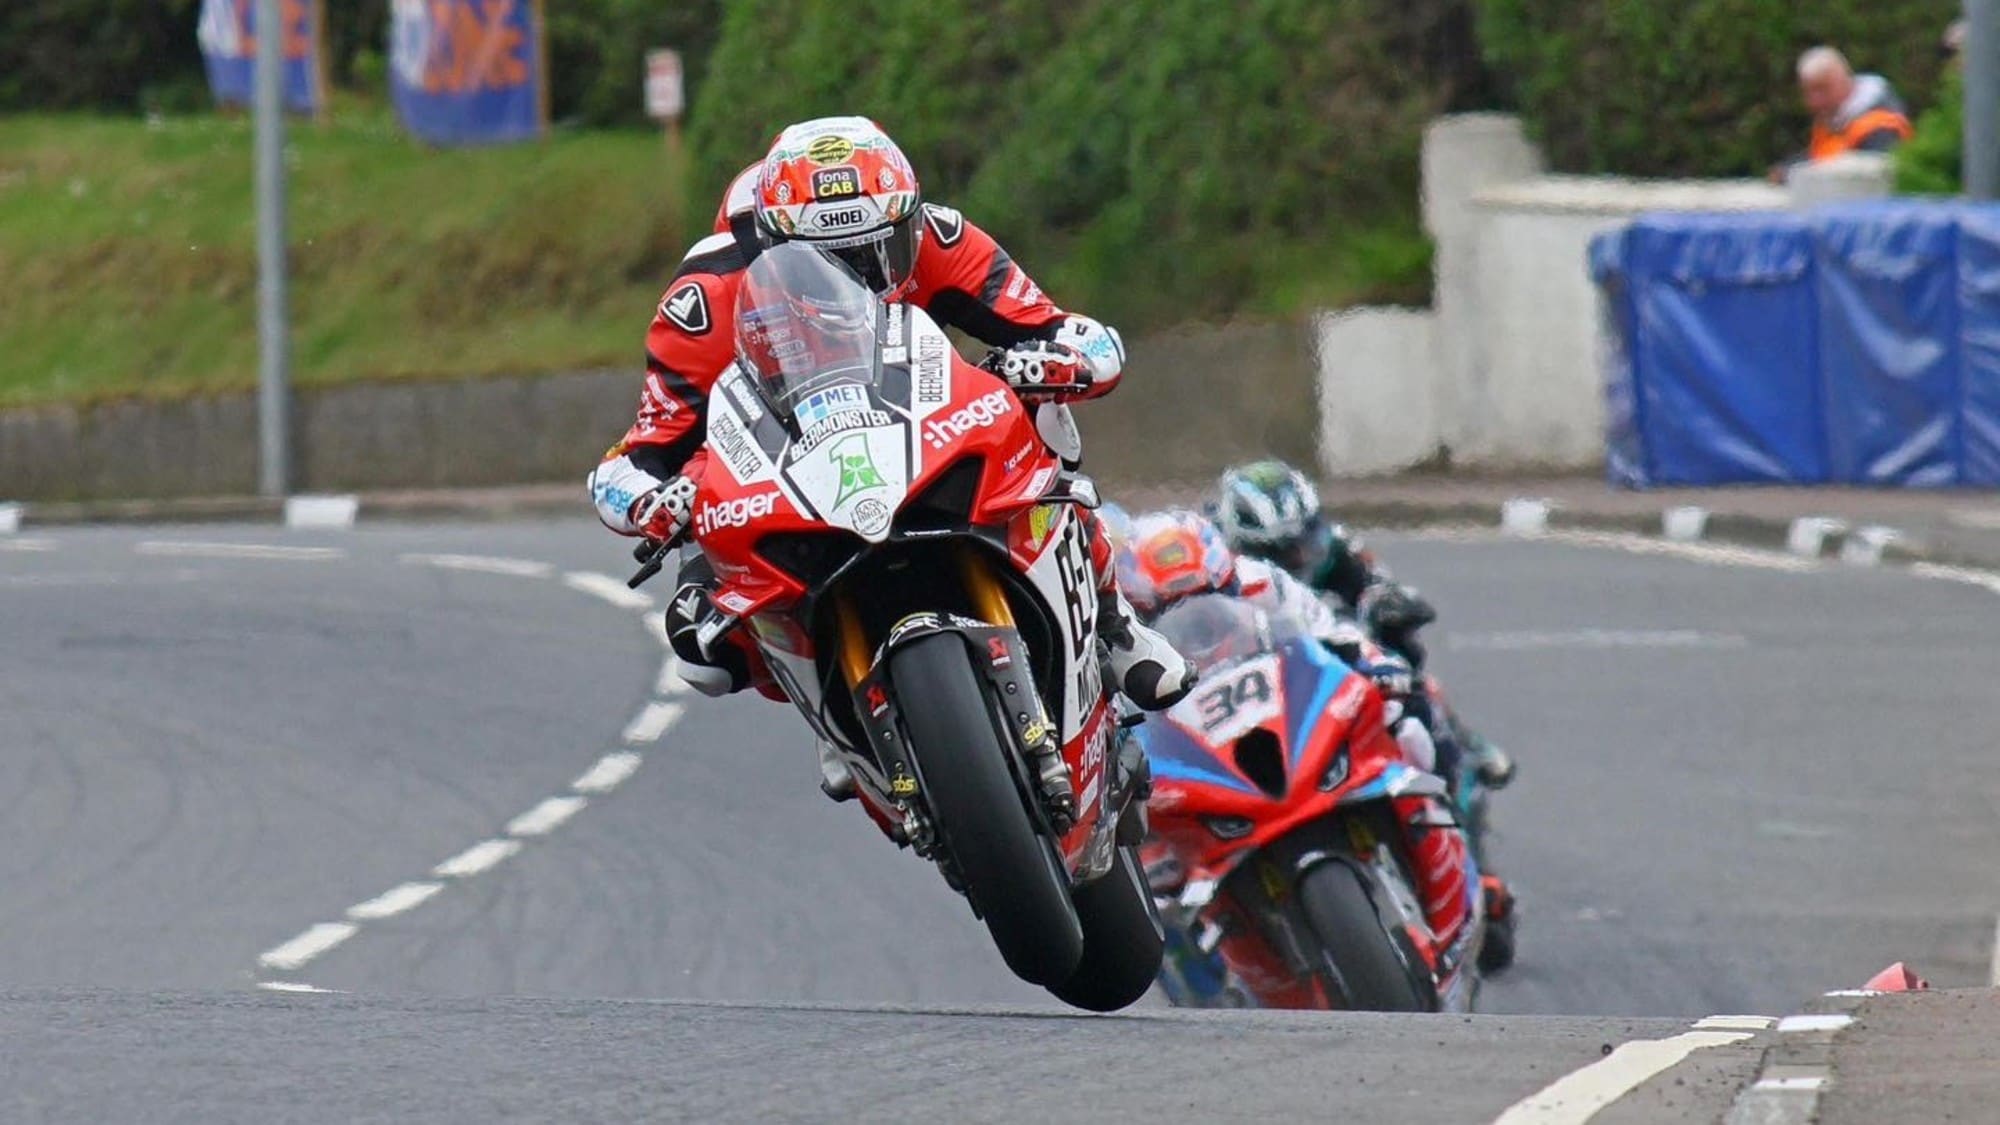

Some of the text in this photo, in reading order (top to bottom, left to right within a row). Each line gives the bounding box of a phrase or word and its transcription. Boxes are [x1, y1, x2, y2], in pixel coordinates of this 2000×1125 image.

[818, 171, 850, 184] fona
[819, 182, 854, 196] CAB
[820, 209, 863, 228] SHOEI
[919, 334, 944, 402] BEERMONSTER
[825, 387, 863, 406] MET
[709, 412, 763, 480] BEERMONSTER
[790, 411, 892, 461] BEERMONSTER
[829, 432, 888, 512] 1
[1201, 671, 1272, 732] 34
